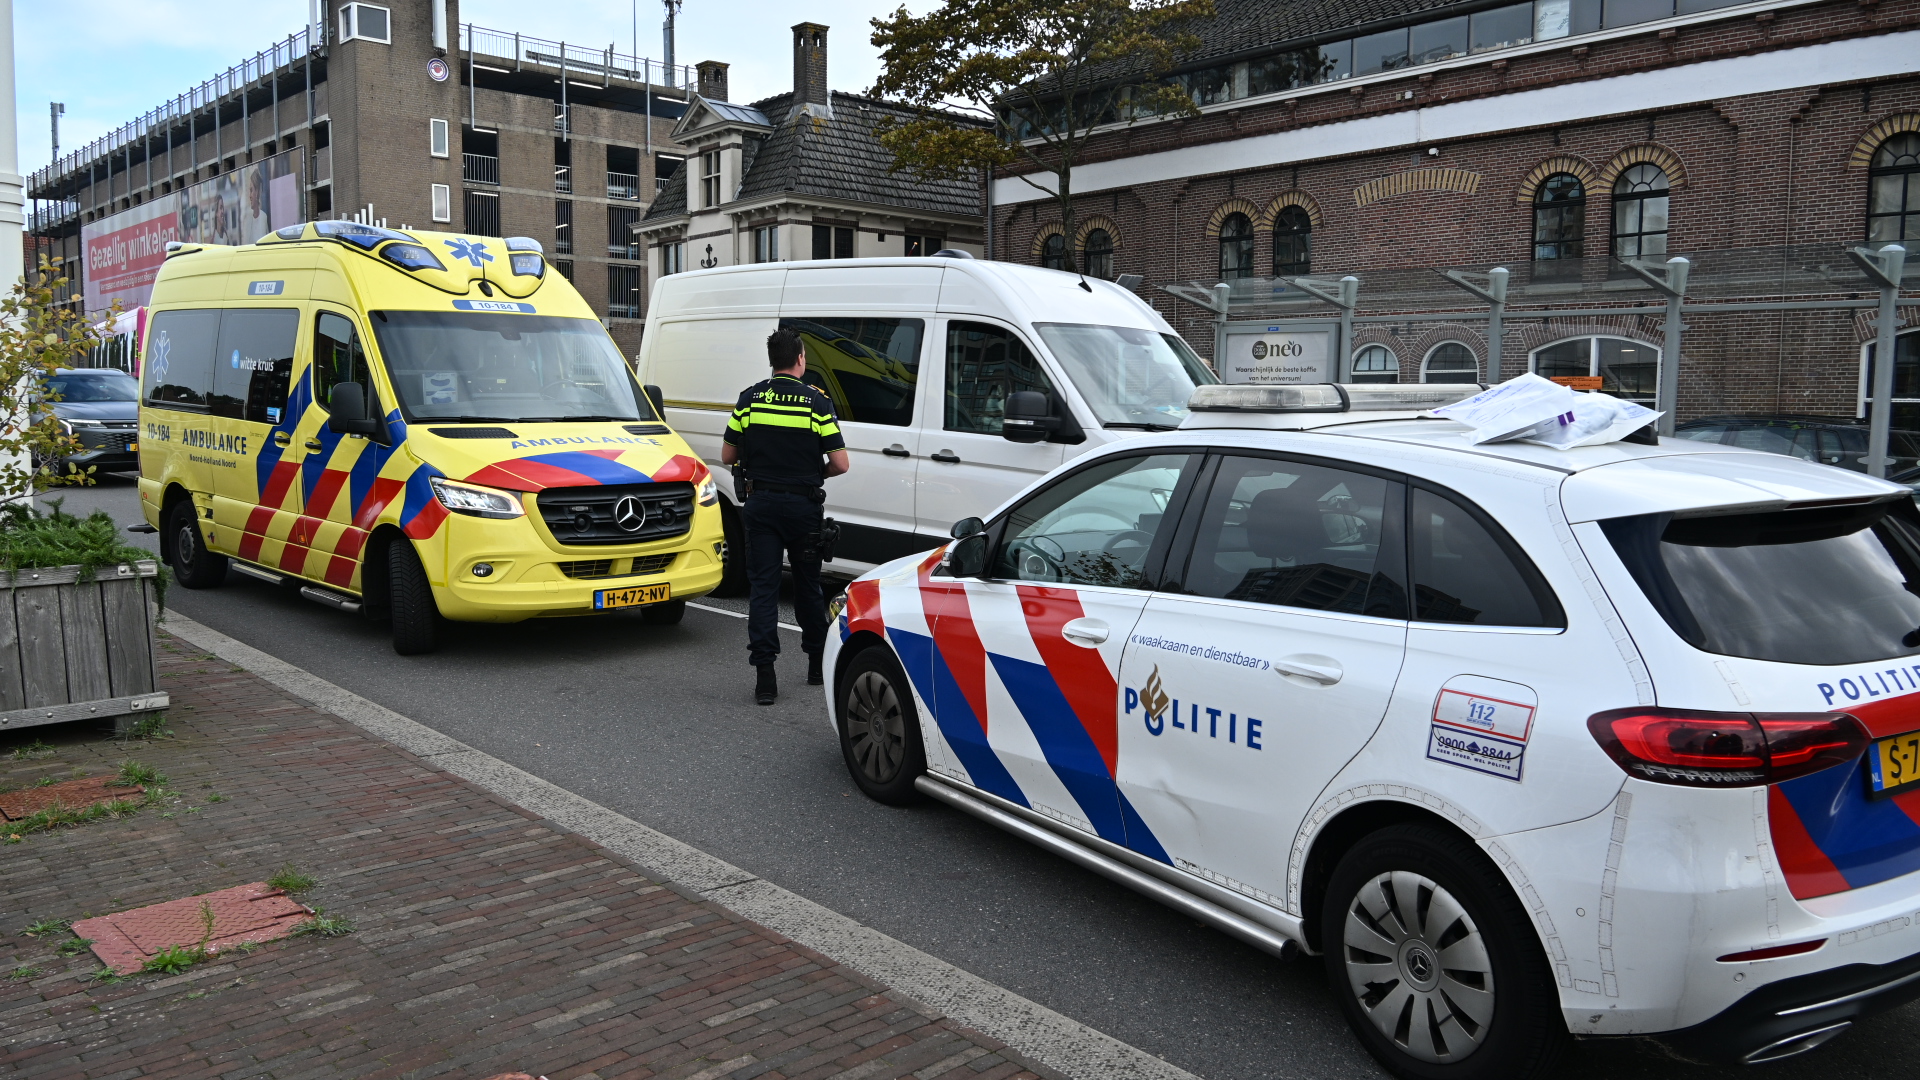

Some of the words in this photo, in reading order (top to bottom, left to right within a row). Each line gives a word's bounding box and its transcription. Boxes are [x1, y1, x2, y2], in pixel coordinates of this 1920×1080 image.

[90, 235, 127, 270] Gezellig
[128, 223, 175, 260] winkelen
[478, 302, 514, 310] 10-184
[240, 356, 257, 370] witte
[257, 357, 275, 372] kruis
[1235, 366, 1274, 374] Waarschijnlijk
[1260, 374, 1270, 382] het
[759, 392, 805, 403] POLITIE
[146, 422, 171, 442] 10-184
[181, 428, 247, 455] AMBULANCE
[511, 436, 663, 450] AMBULANCE
[221, 459, 237, 469] Noord
[606, 586, 666, 606] H-472-NV
[1189, 645, 1203, 657] en
[1124, 685, 1262, 751] POLITIE
[1437, 736, 1465, 752] 0900
[1481, 746, 1512, 763] 8844
[1473, 757, 1486, 765] WEL
[1487, 761, 1511, 771] POLITIE
[1871, 772, 1882, 784] NL
